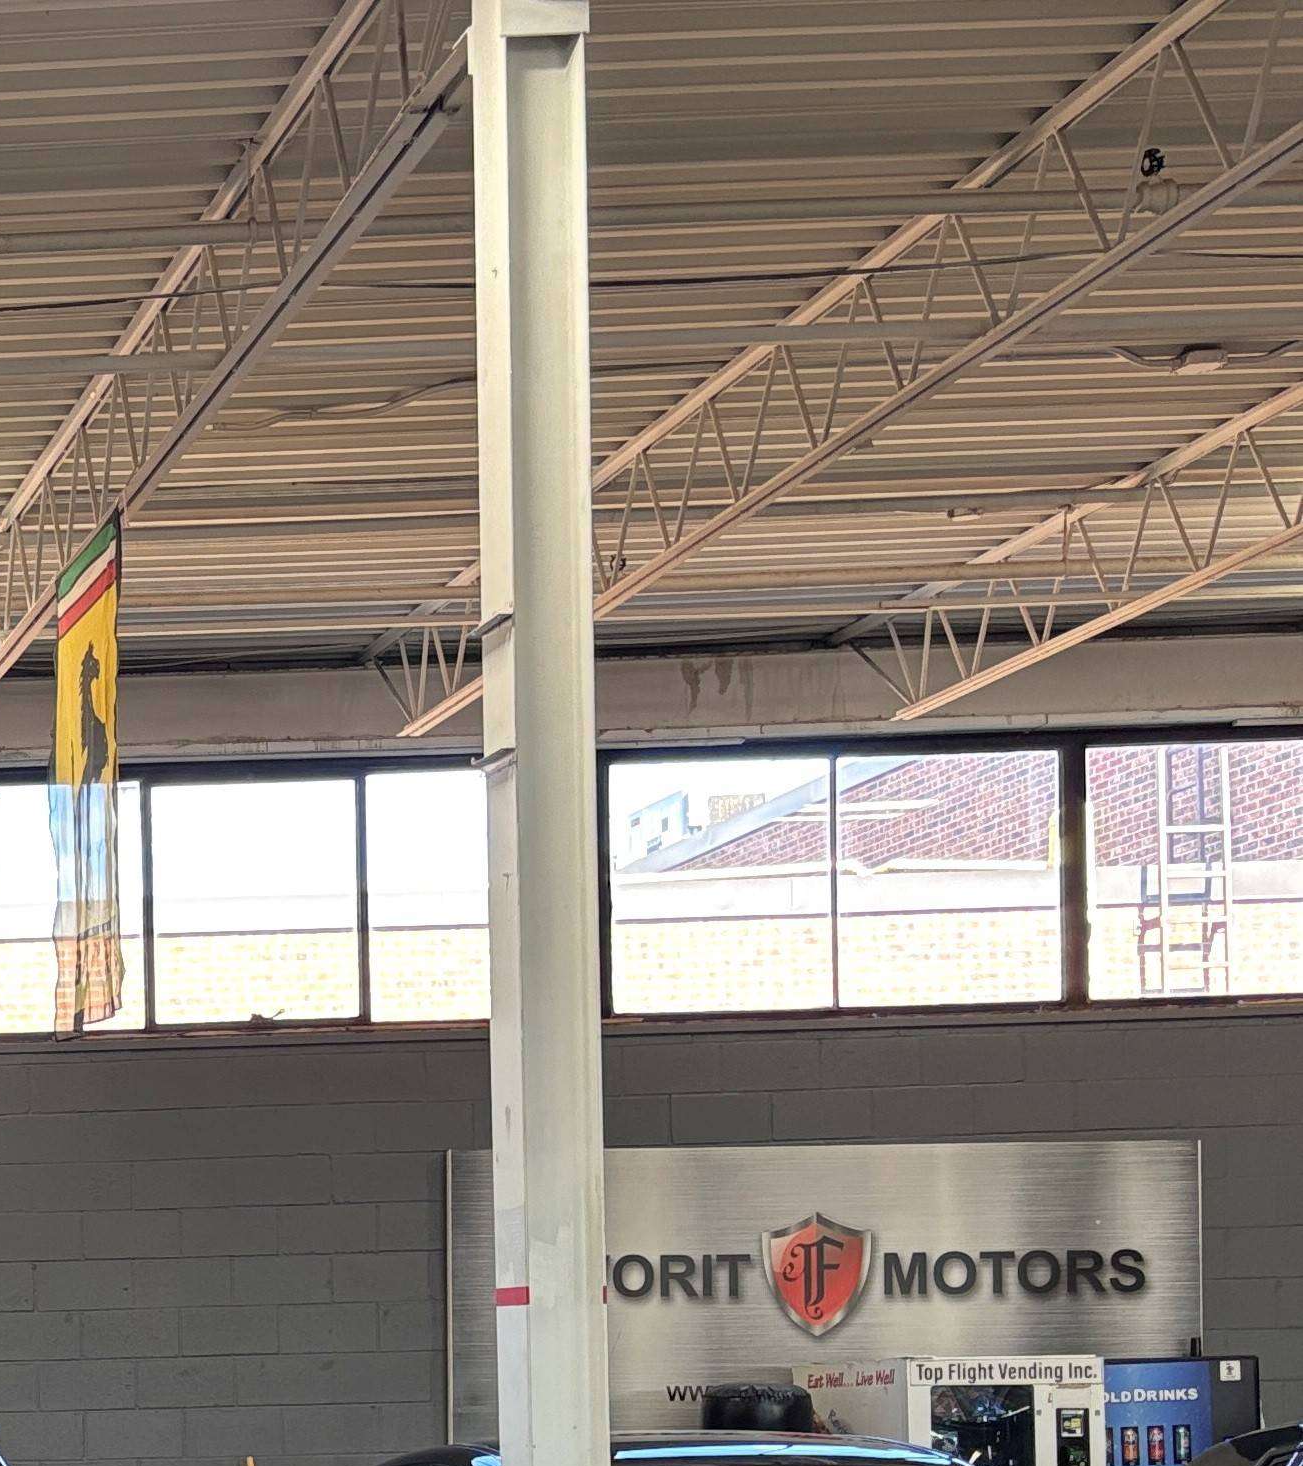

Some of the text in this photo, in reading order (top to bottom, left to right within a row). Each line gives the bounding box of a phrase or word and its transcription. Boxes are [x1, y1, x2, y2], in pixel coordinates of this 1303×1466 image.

[606, 1253, 751, 1298] ORIT
[883, 1248, 1147, 1296] MOTORS
[807, 1374, 824, 1389] Eat
[856, 1371, 874, 1387] Live
[876, 1369, 895, 1386] Well
[916, 1362, 1098, 1384] Top Flight Vending Inc.
[1133, 1387, 1199, 1402] DRINKS
